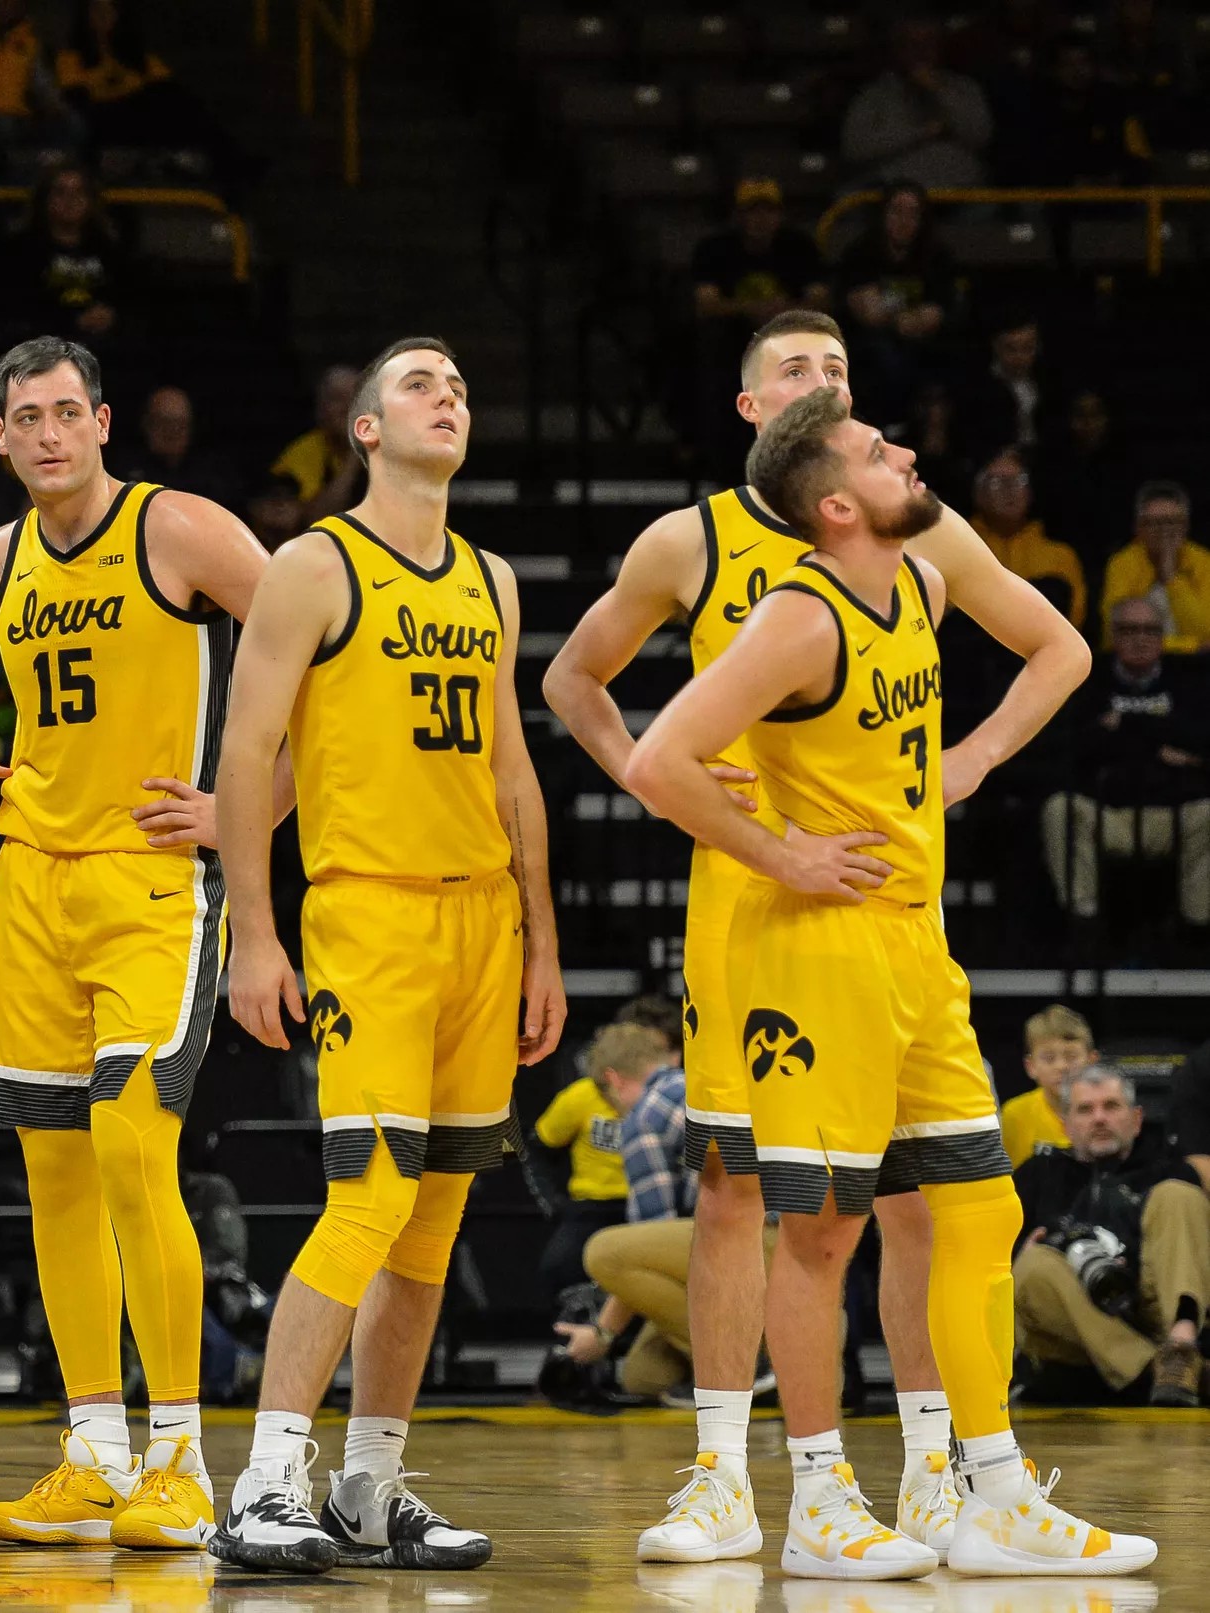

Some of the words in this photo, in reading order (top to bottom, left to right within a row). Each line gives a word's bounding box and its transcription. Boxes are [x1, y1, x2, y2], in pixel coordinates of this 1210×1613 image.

[7, 589, 126, 645] Iowa
[381, 604, 497, 665] Iowa
[32, 647, 97, 728] 15
[410, 672, 484, 755] 30
[899, 724, 928, 811] 3
